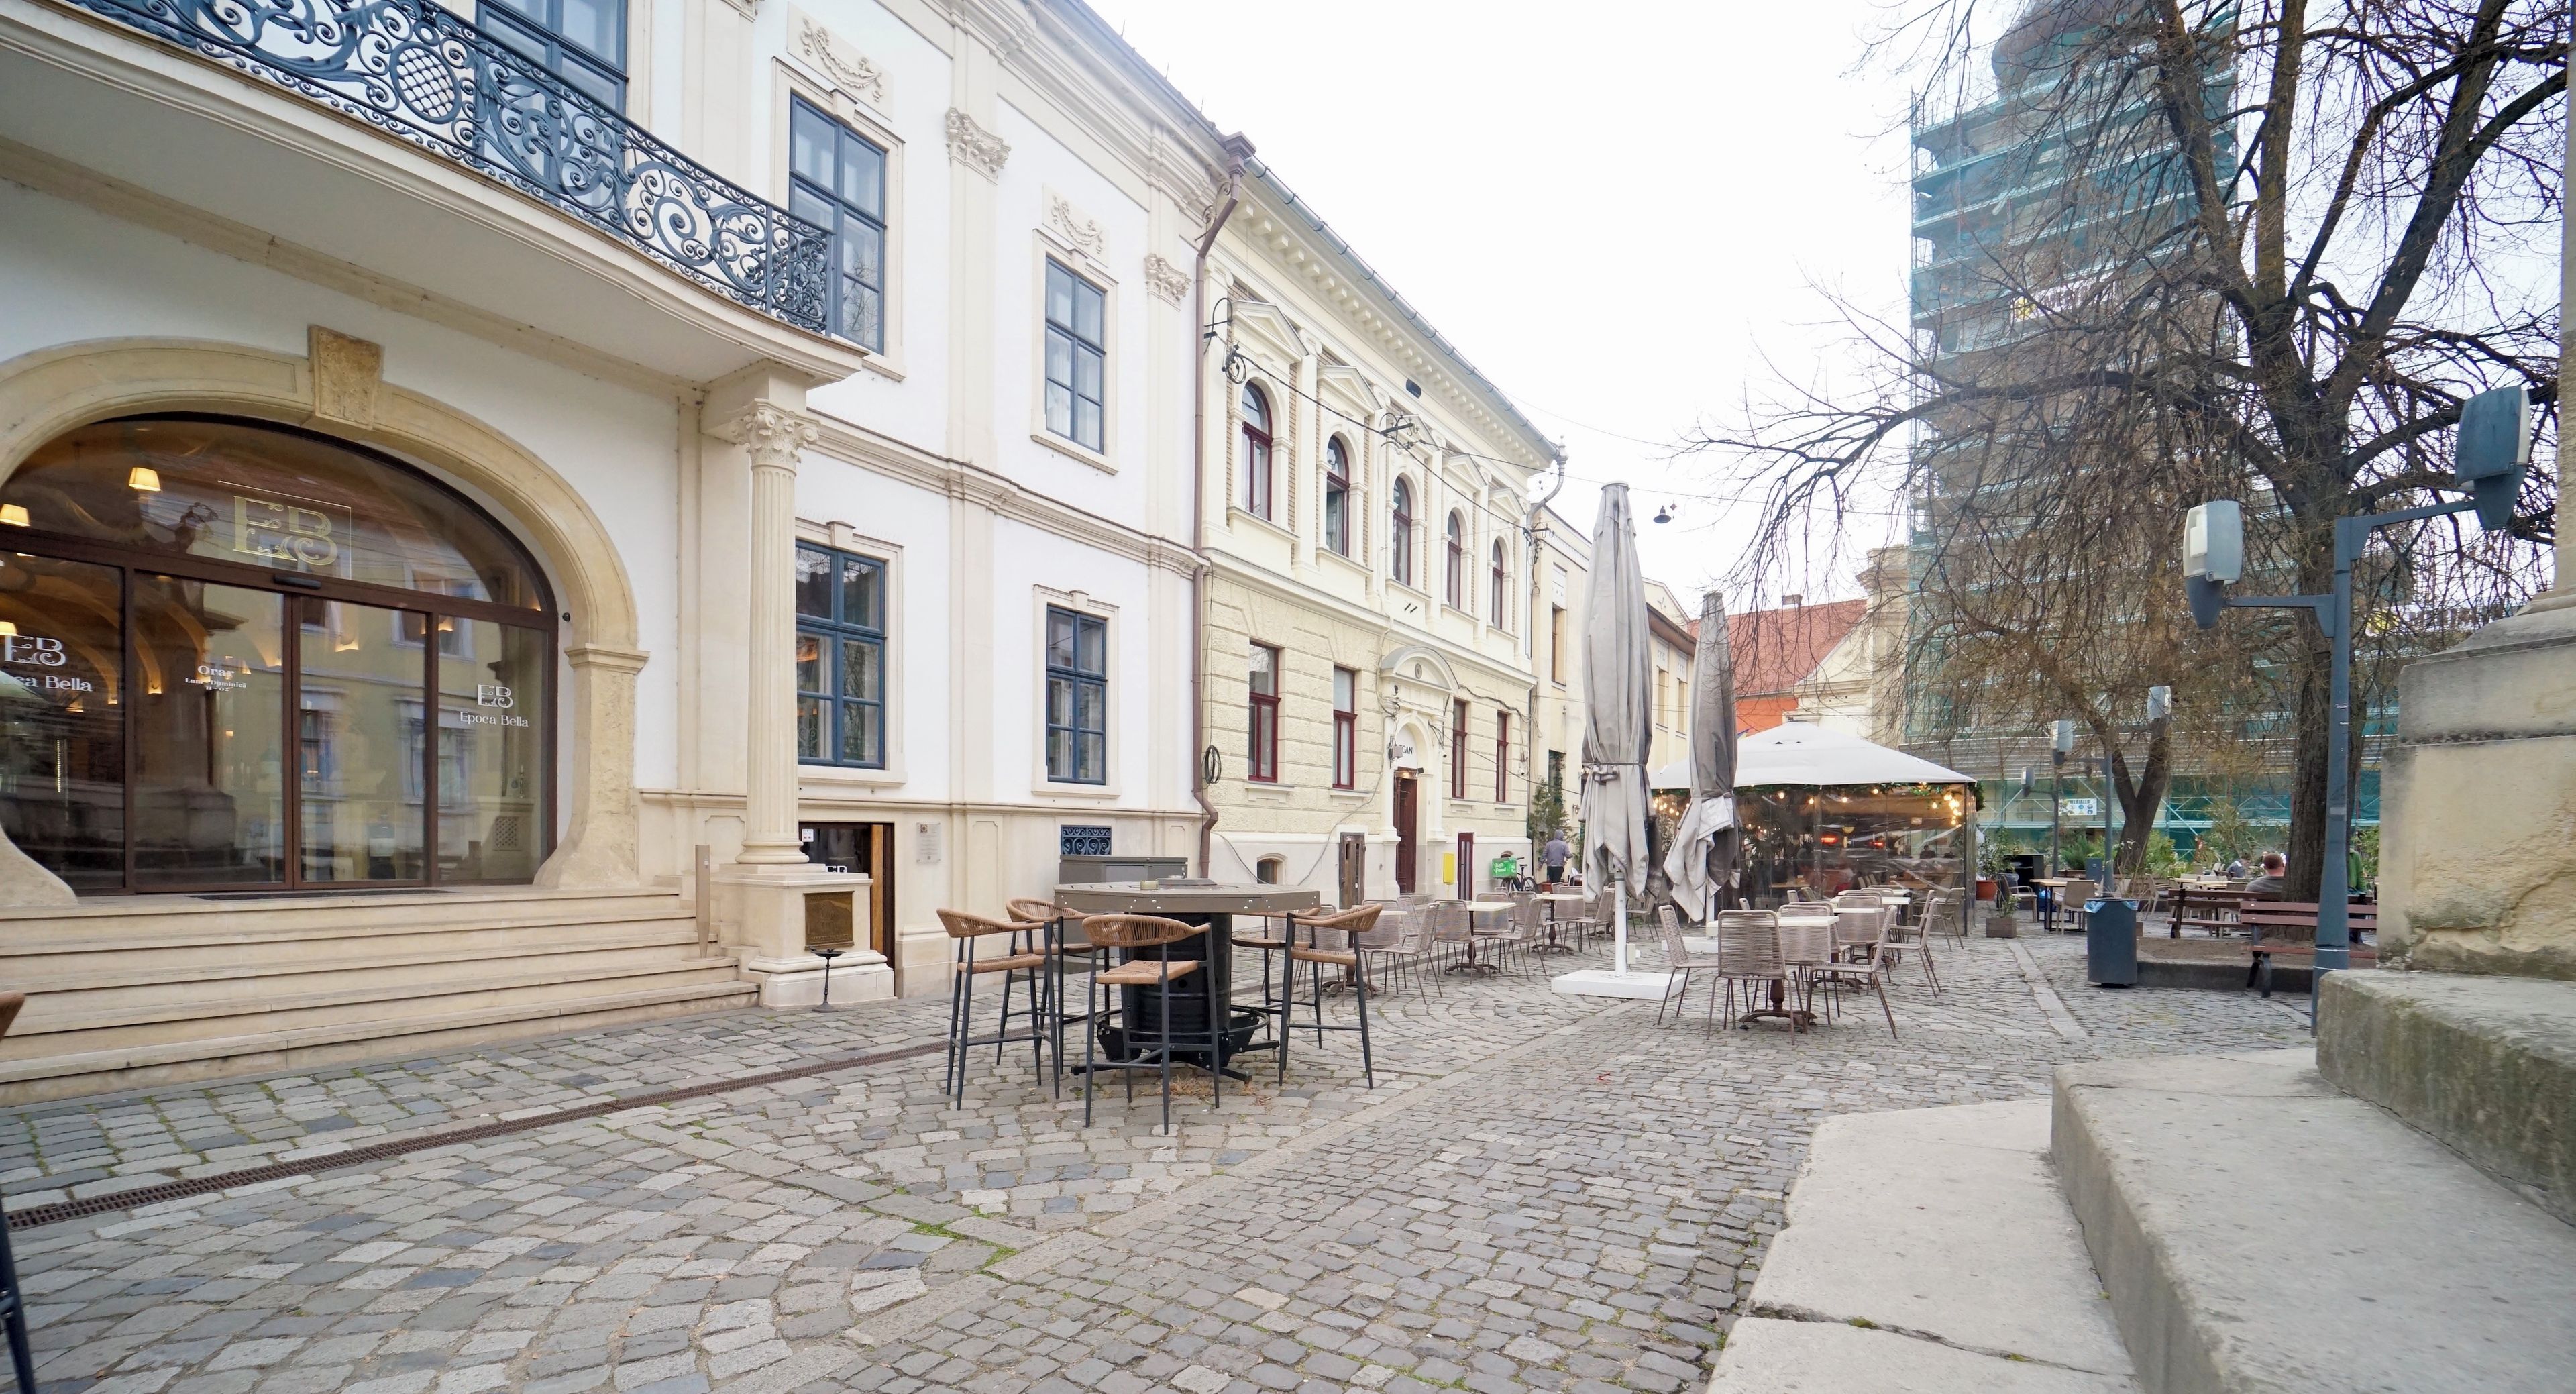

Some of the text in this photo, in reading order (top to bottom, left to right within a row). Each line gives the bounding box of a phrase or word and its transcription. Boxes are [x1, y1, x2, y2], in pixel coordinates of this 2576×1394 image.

[198, 665, 235, 678] Orar
[45, 675, 93, 692] Bella
[478, 684, 513, 708] EB
[460, 711, 529, 727] Epoca Bella
